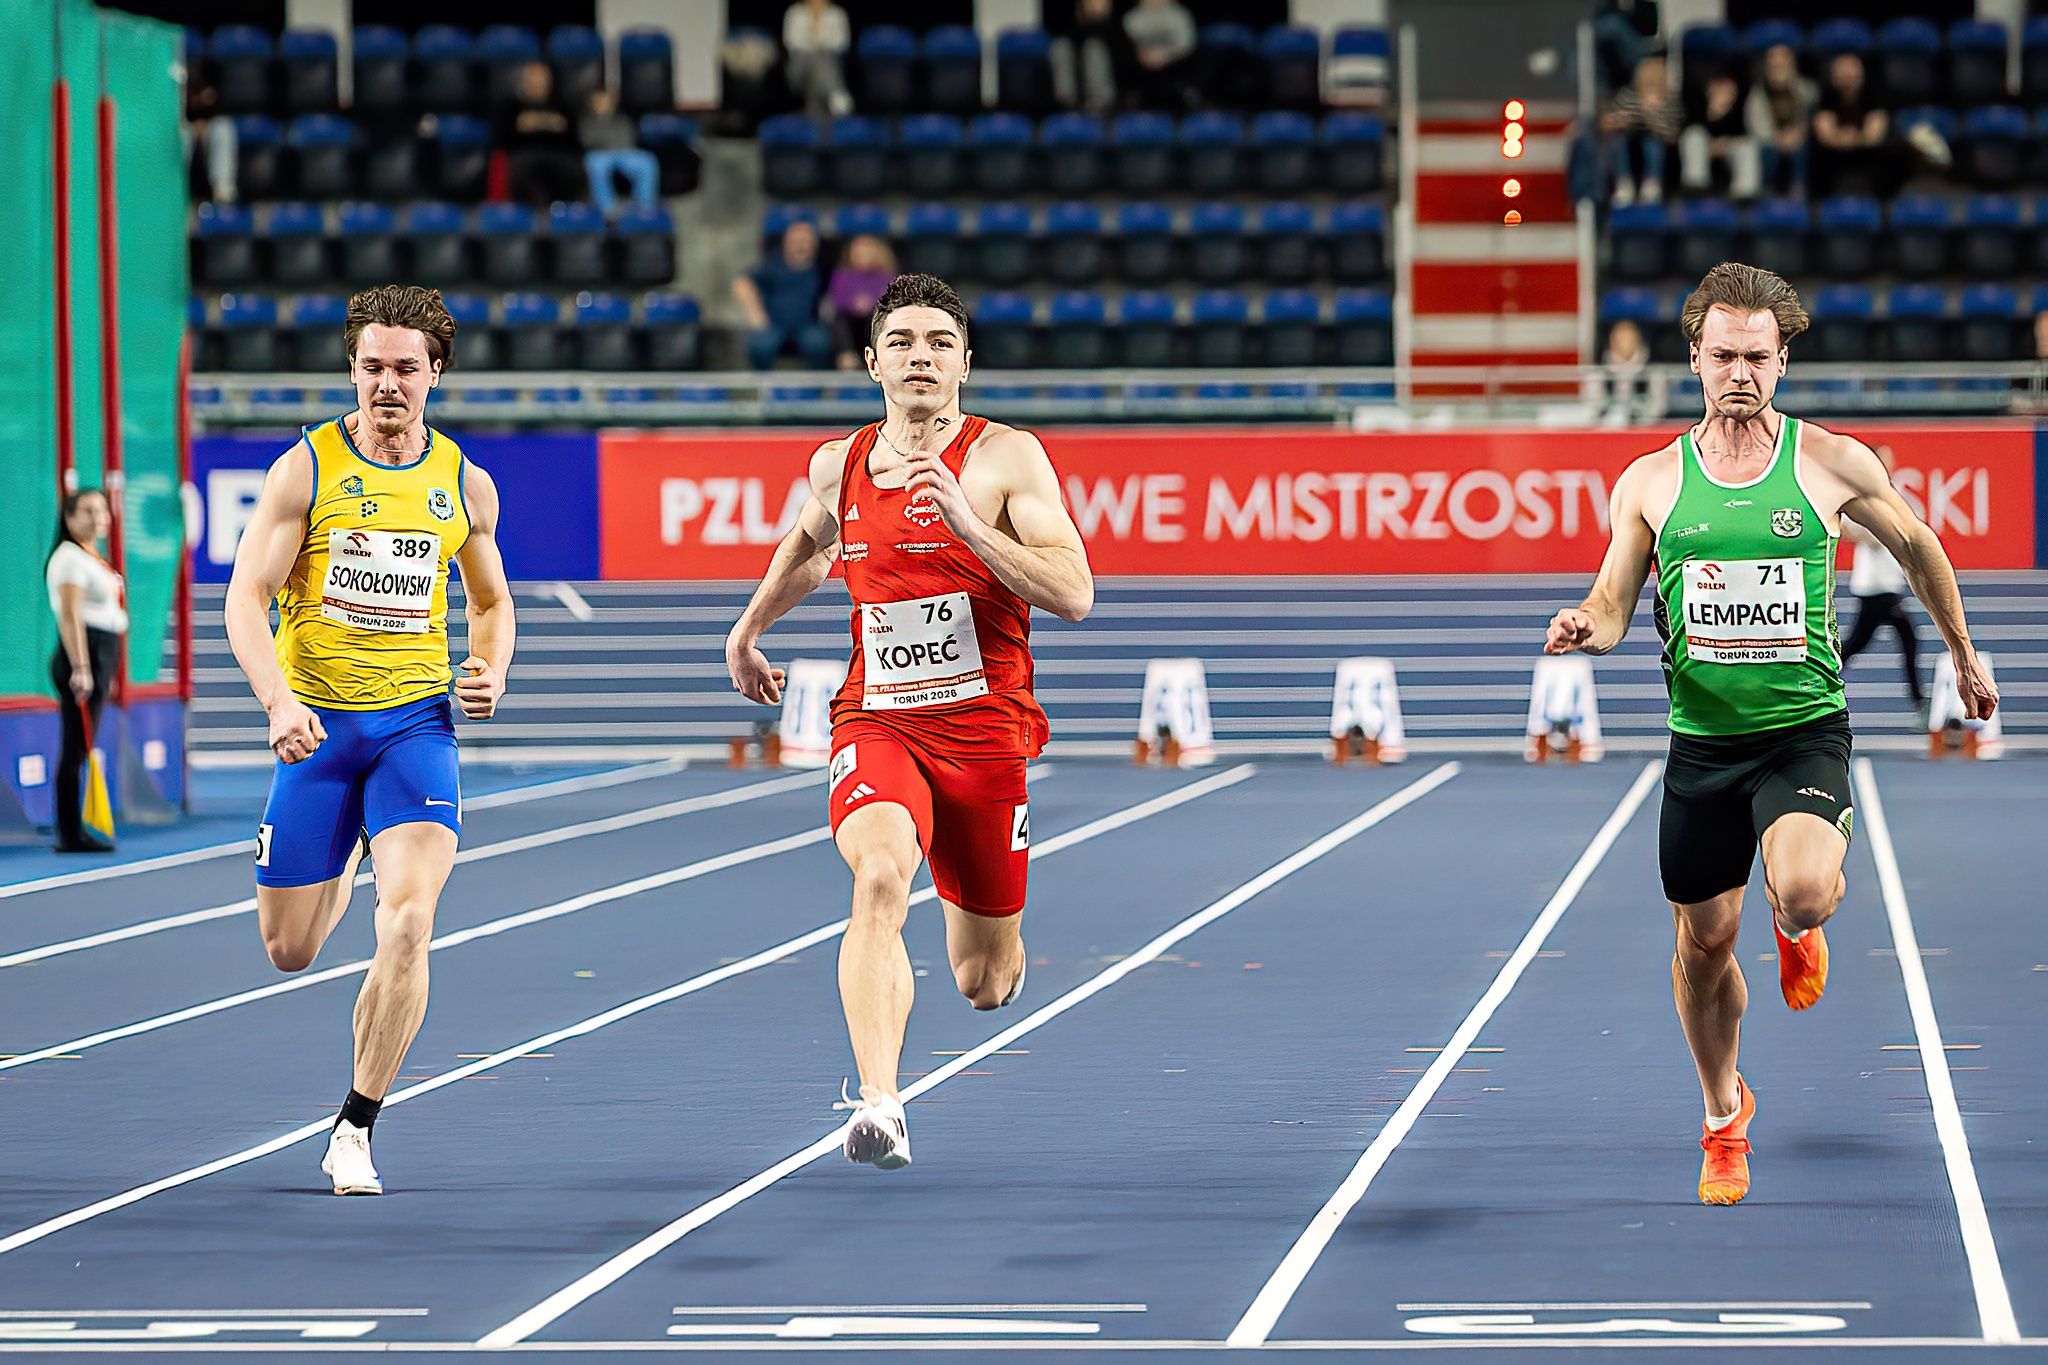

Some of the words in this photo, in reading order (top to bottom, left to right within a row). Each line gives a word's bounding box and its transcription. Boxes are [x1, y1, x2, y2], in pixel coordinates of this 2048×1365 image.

[342, 548, 372, 558] ORLEN
[392, 538, 431, 559] 389
[329, 565, 432, 597] SOKOŁOWSKI
[1697, 582, 1726, 590] ORLEN
[1757, 564, 1787, 586] 71
[346, 614, 381, 627] TORUŃ
[920, 600, 953, 624] 76
[1688, 601, 1799, 626] LEMPACH
[875, 633, 961, 670] KOPEĆ
[1713, 649, 1751, 660] TORUŃ
[893, 693, 928, 705] TORUŃ
